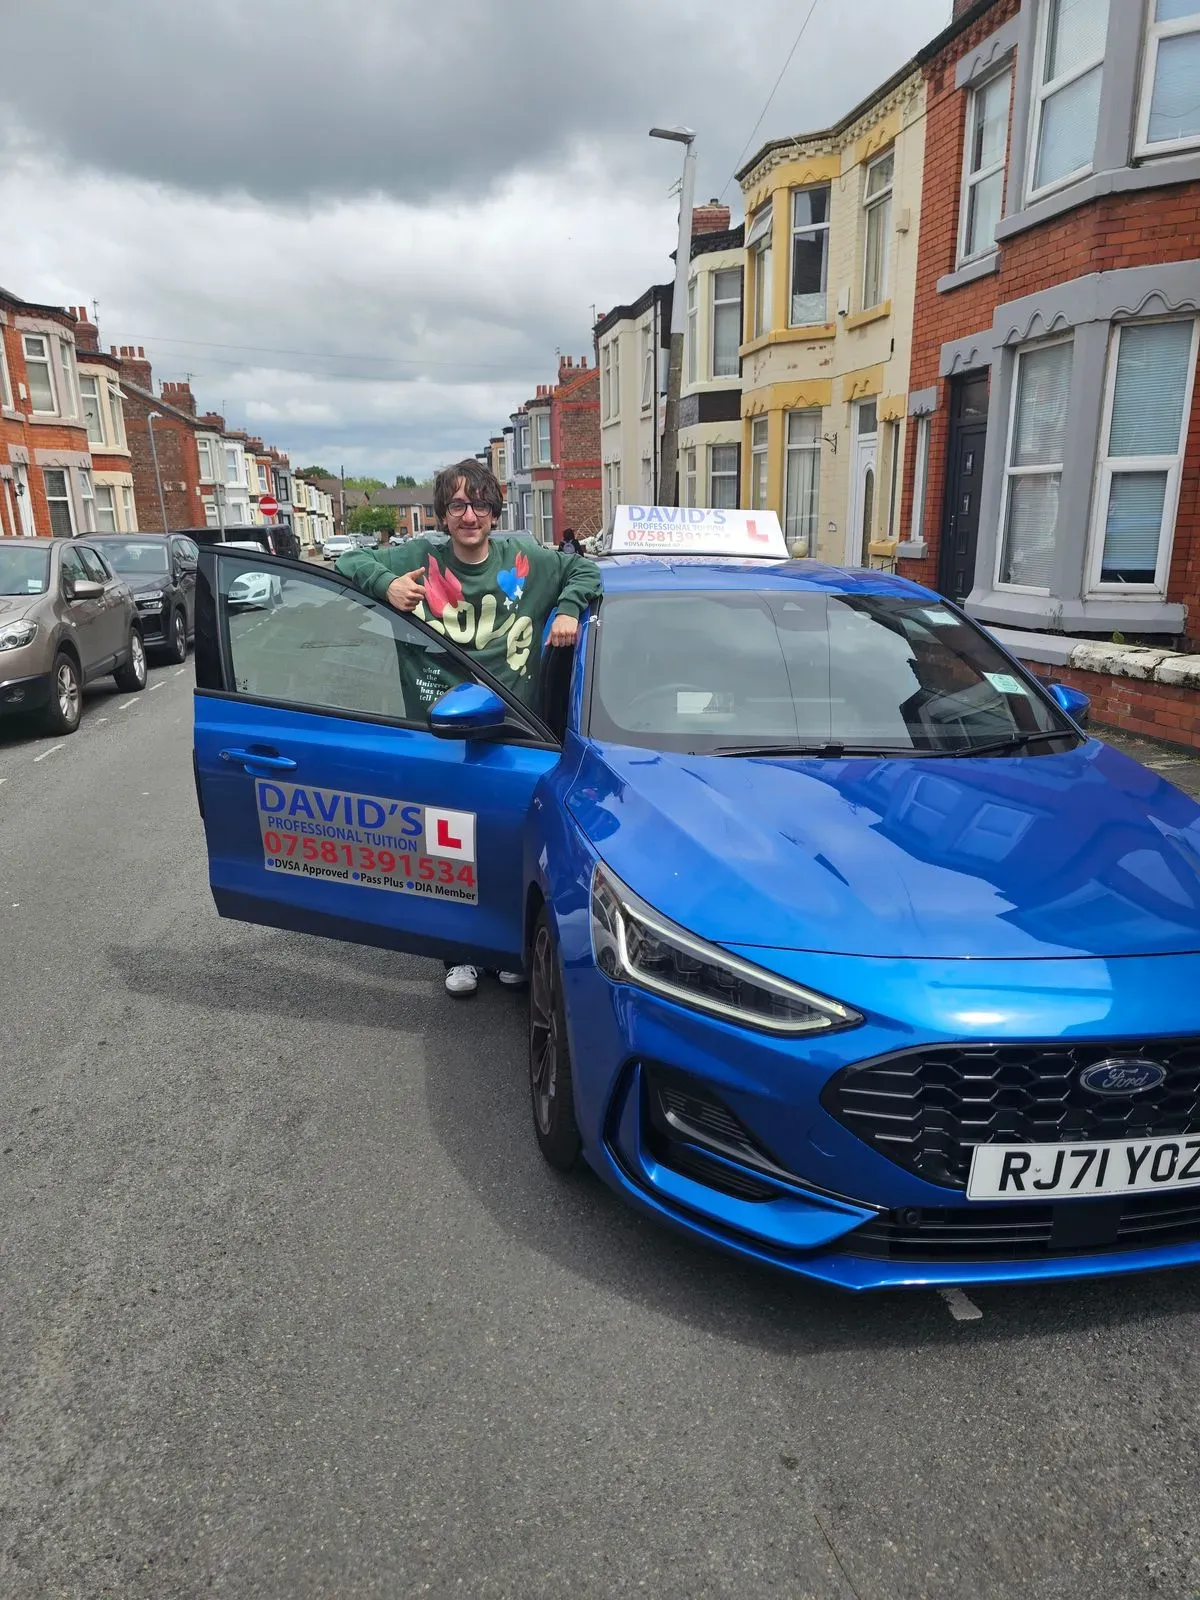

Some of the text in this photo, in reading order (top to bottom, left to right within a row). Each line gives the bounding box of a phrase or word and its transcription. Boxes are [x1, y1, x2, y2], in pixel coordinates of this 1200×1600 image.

[628, 505, 727, 525] DAVID'S
[633, 522, 691, 531] PROFESSIONAL
[746, 519, 769, 542] L
[258, 782, 424, 837] DAVID'S
[268, 815, 417, 853] PROFESSIONAL TUITION
[437, 818, 462, 850] L
[264, 831, 475, 888] 07581391534
[274, 858, 349, 880] DVSA Approved
[360, 873, 404, 889] Pass Plus
[414, 881, 476, 901] DIA Member
[1102, 1067, 1149, 1088] Ford
[998, 1148, 1111, 1191] RJ71
